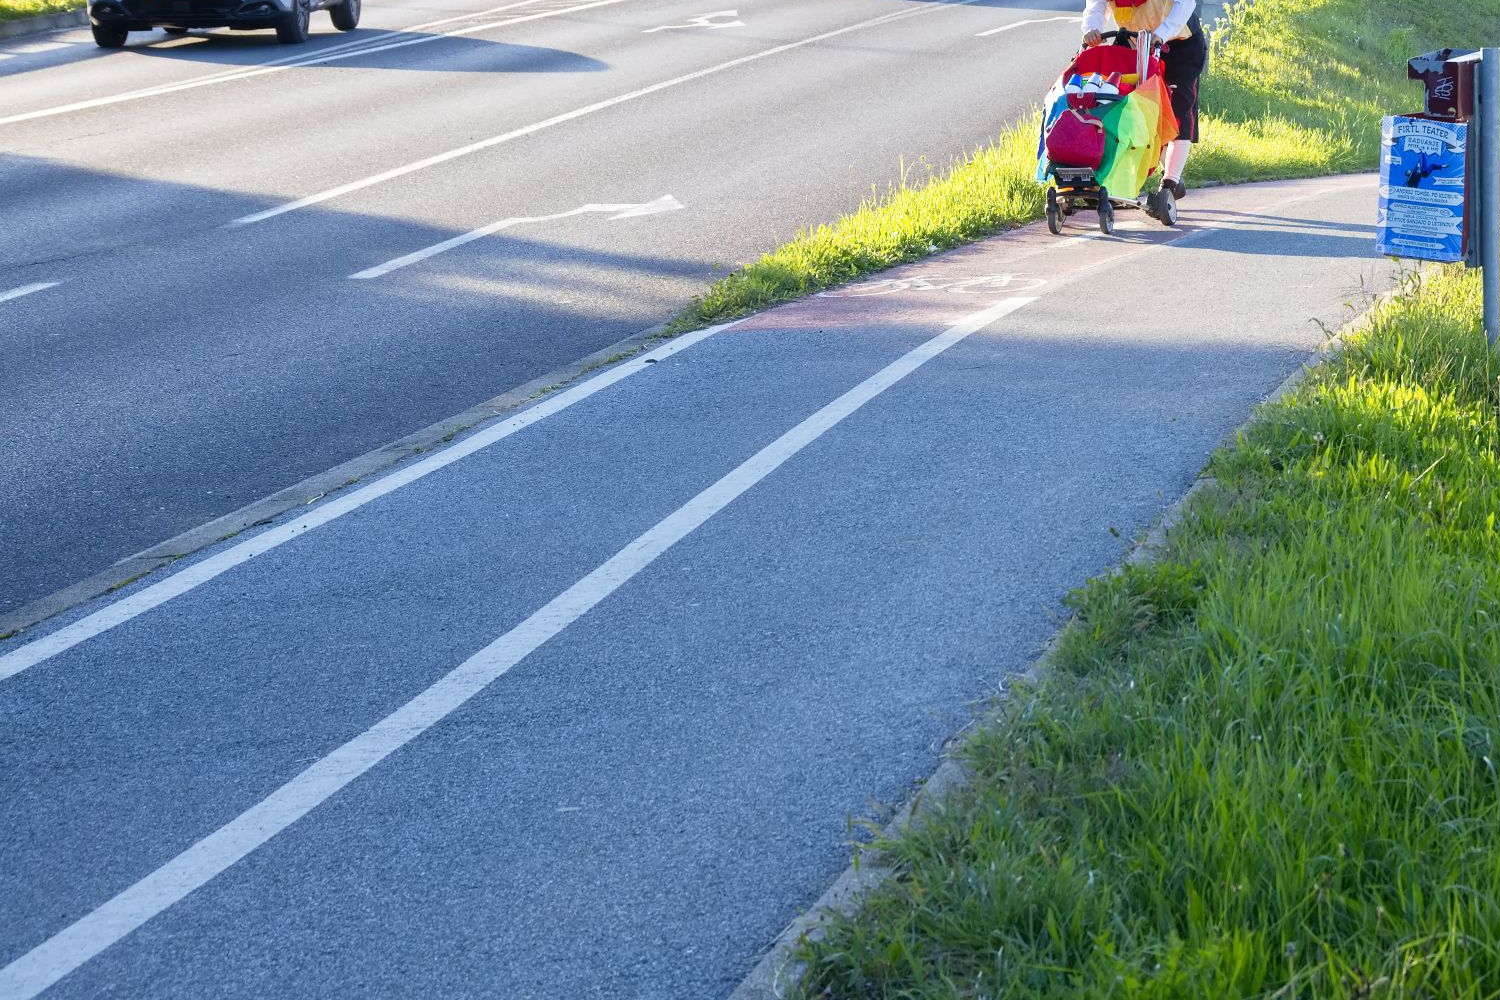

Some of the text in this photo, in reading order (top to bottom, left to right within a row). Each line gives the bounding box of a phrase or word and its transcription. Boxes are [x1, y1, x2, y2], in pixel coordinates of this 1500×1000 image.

[1398, 125, 1449, 139] FIRTL TEATER
[1408, 137, 1440, 148] RADVANJE
